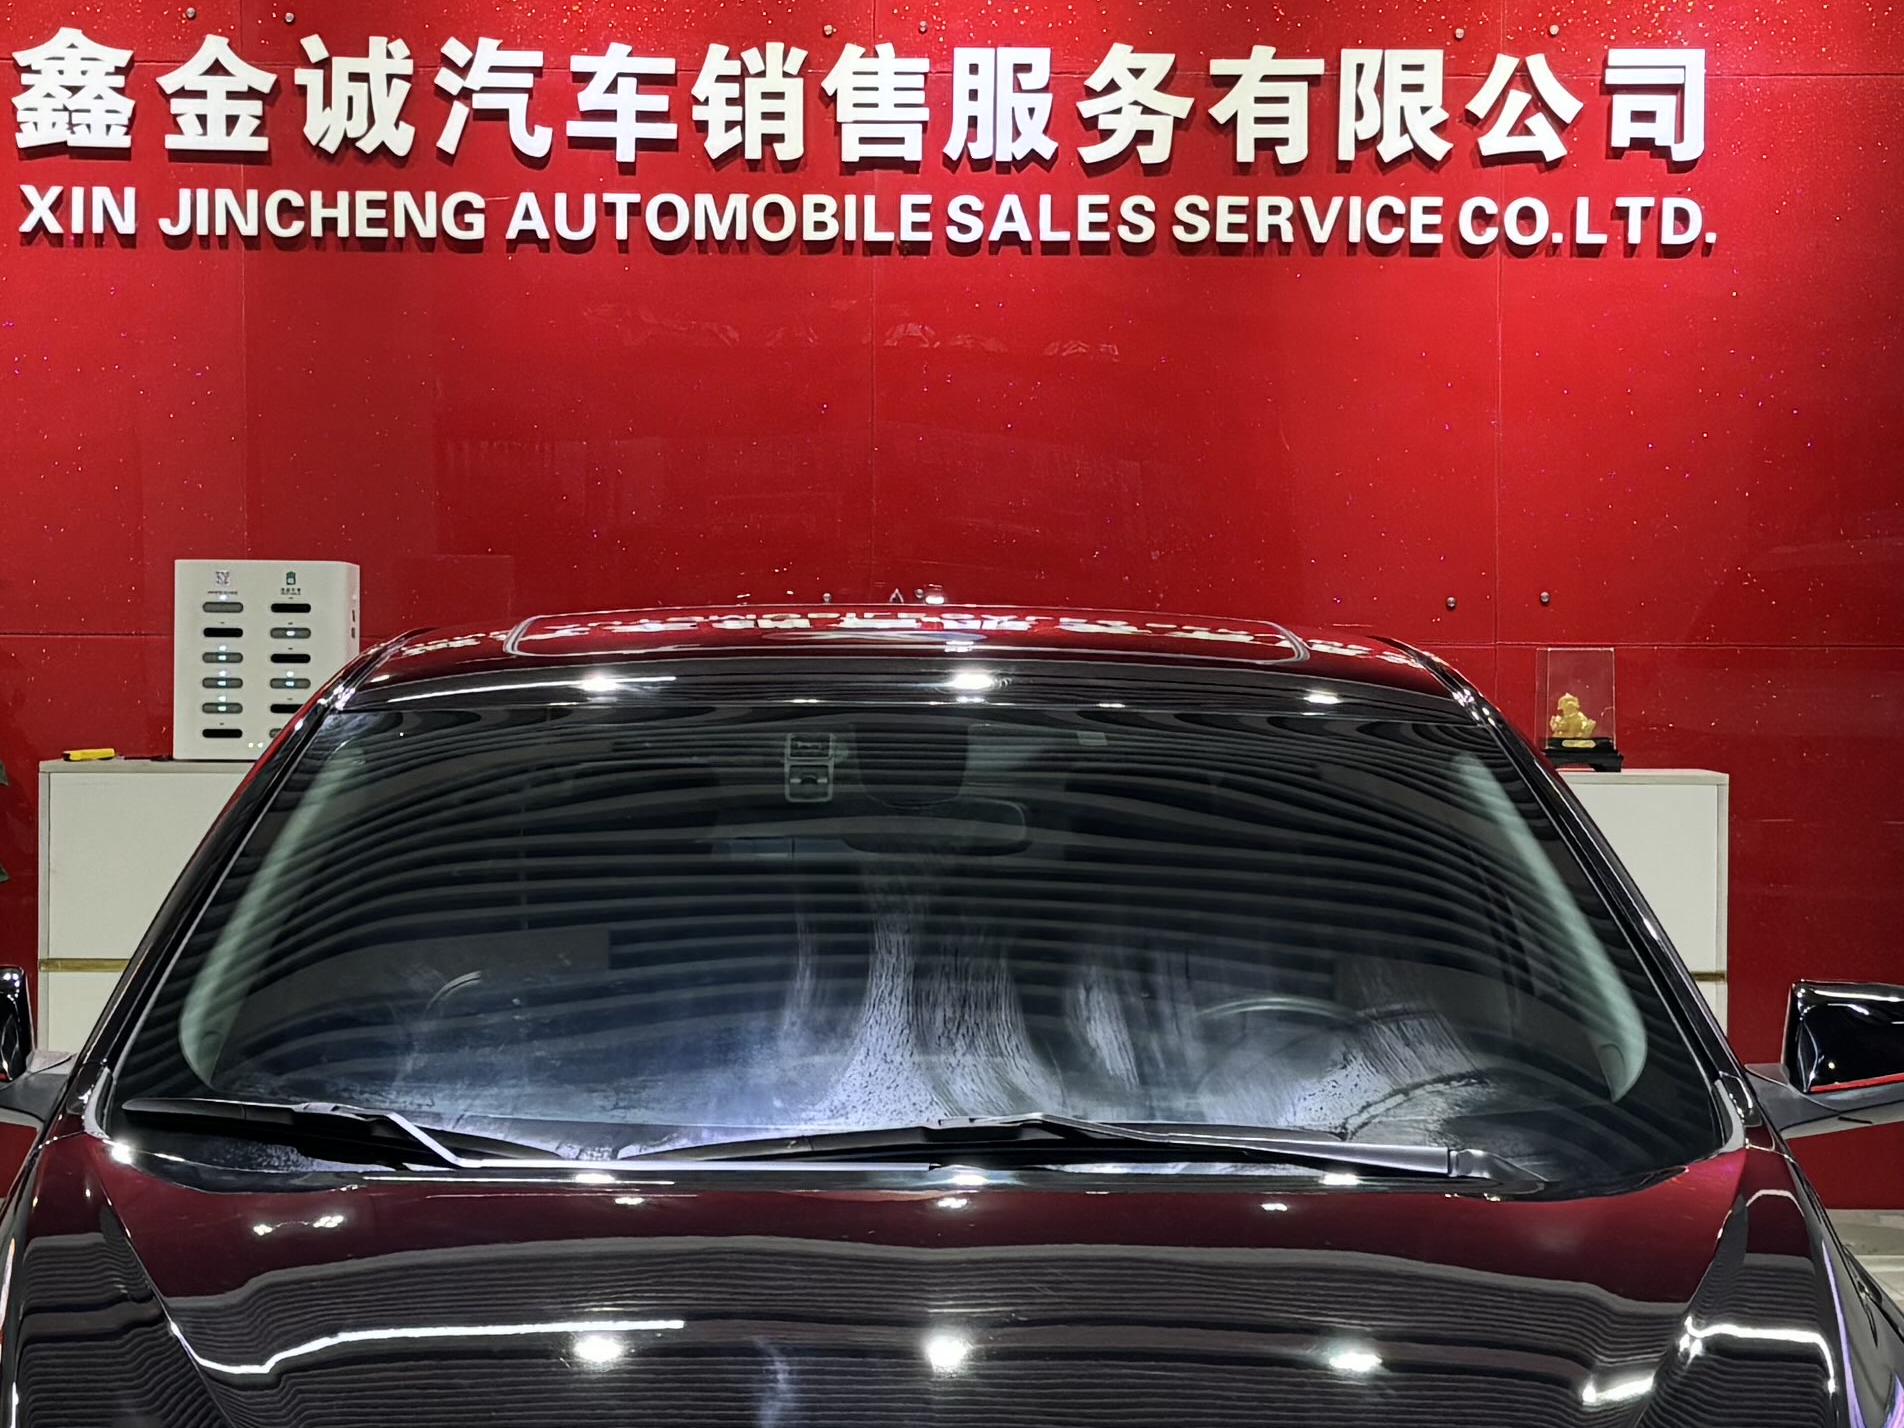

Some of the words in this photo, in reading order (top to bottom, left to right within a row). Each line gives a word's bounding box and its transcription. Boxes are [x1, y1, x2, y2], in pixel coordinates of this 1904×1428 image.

[10, 27, 1708, 164] 鑫金诚汽车销售服务有限公司
[19, 185, 136, 236] XIN
[158, 187, 486, 241] JINCHENG
[505, 191, 933, 243] AUTOMOBILE
[946, 193, 1155, 244] SALES
[1172, 195, 1445, 245] SERVICE
